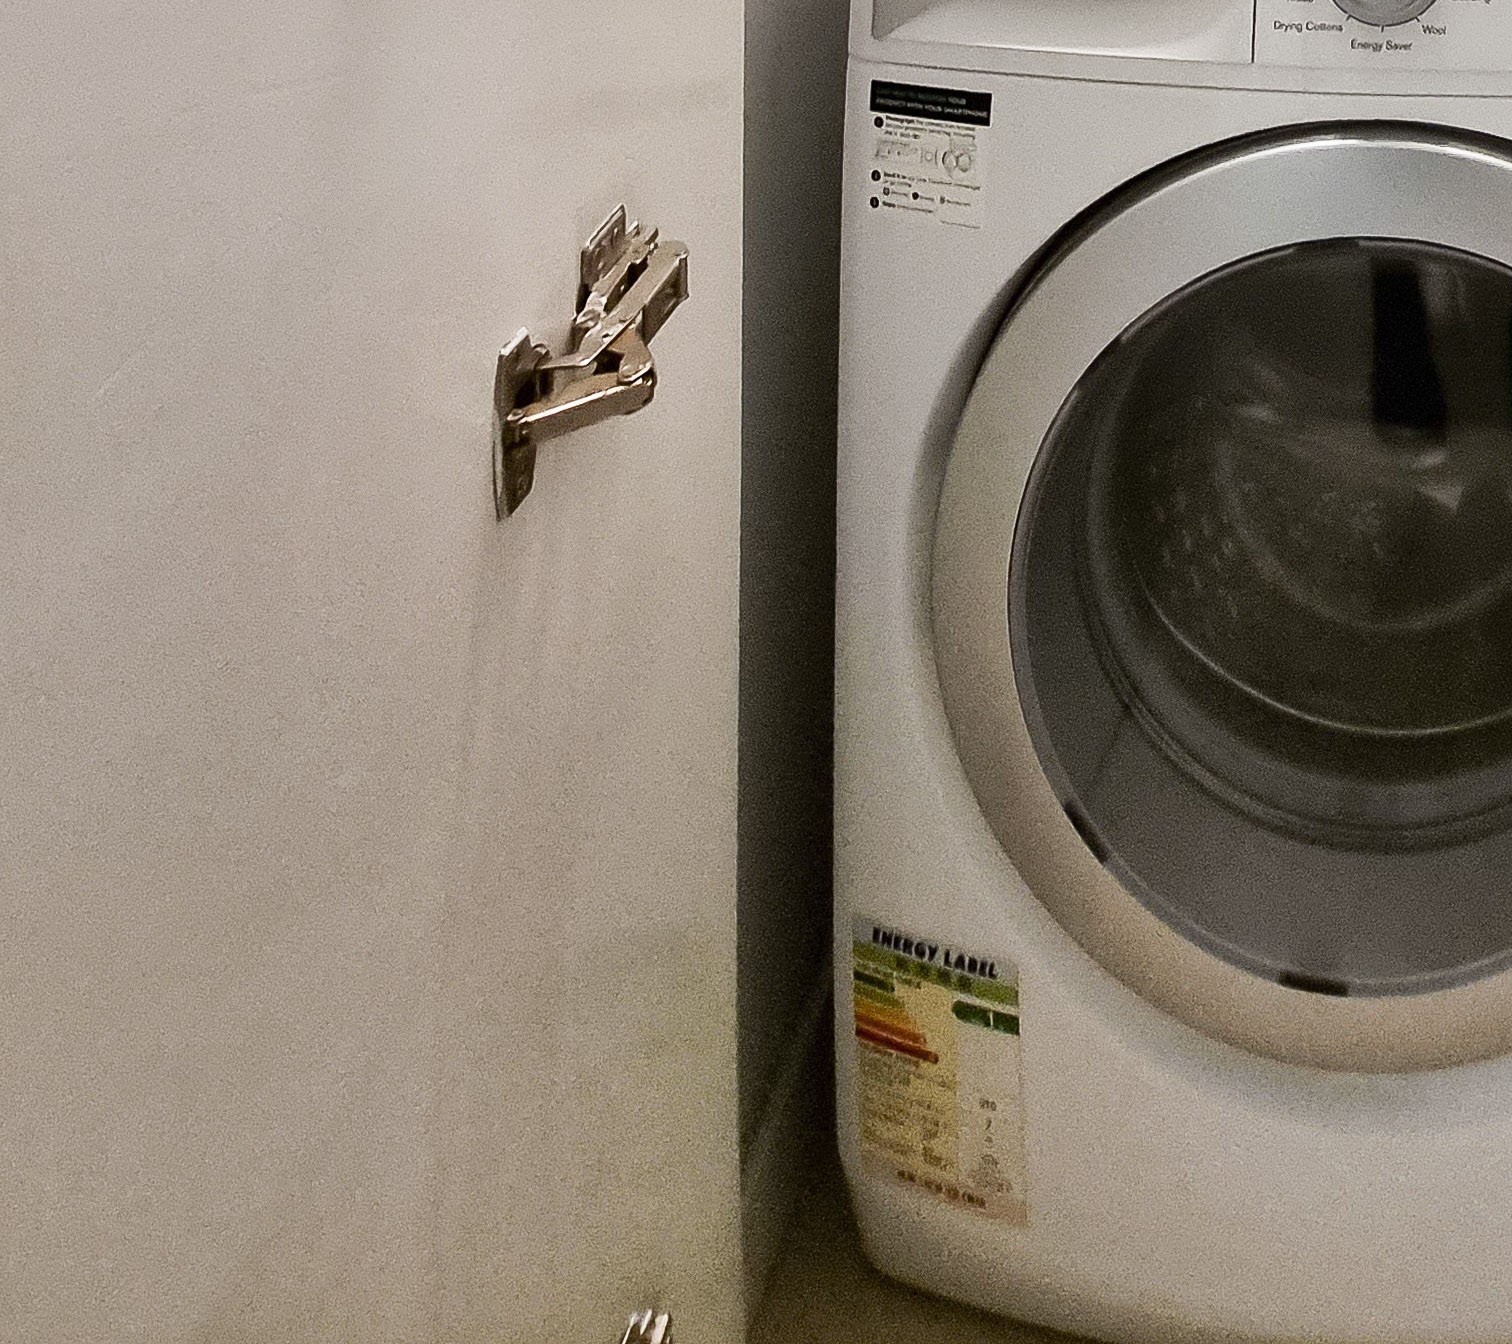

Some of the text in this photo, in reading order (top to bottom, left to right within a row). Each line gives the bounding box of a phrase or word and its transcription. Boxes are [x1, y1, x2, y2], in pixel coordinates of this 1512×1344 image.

[1273, 20, 1343, 33] Drying Cottons
[1421, 24, 1447, 36] Wool
[1350, 39, 1413, 52] Energy Saver
[872, 926, 939, 963] ENERGY
[943, 948, 998, 980] LABEL
